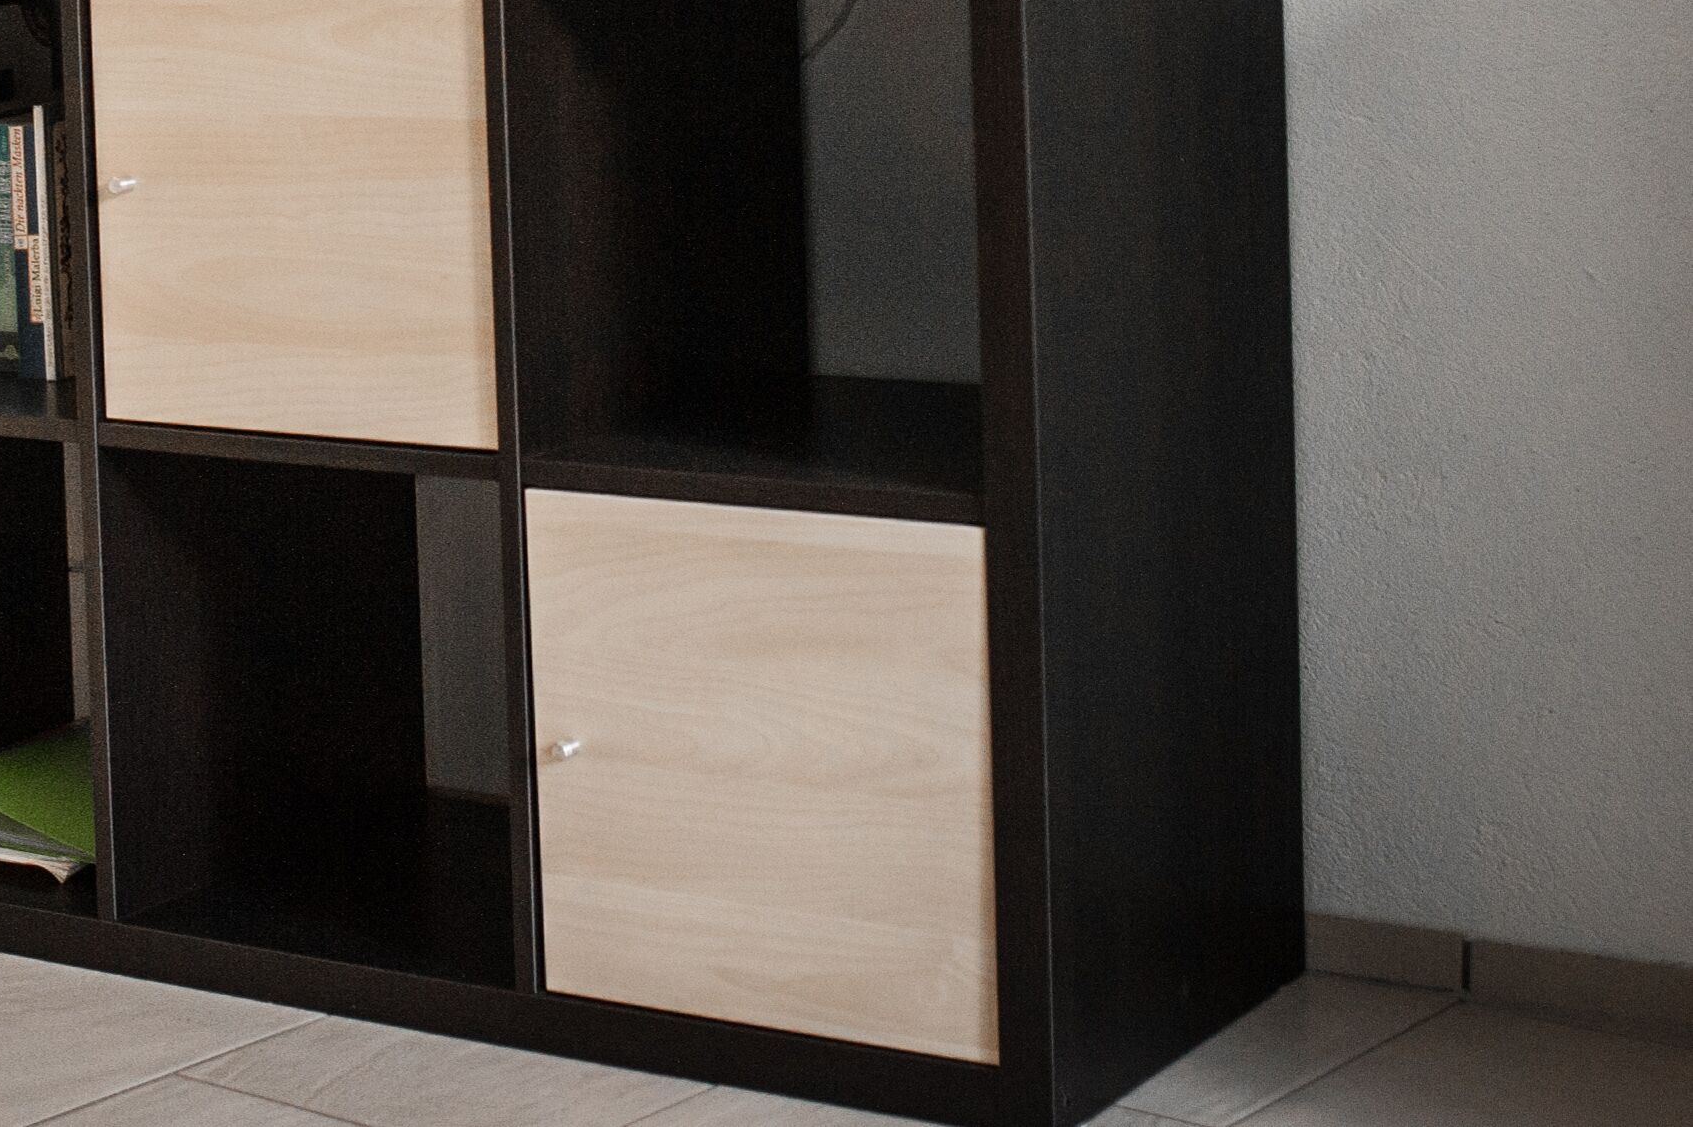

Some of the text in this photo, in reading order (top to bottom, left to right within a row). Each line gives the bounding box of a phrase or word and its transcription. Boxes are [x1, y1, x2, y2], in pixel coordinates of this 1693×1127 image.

[12, 128, 22, 169] Masken
[13, 172, 24, 211] nackten
[31, 238, 43, 313] Luigi Malerba
